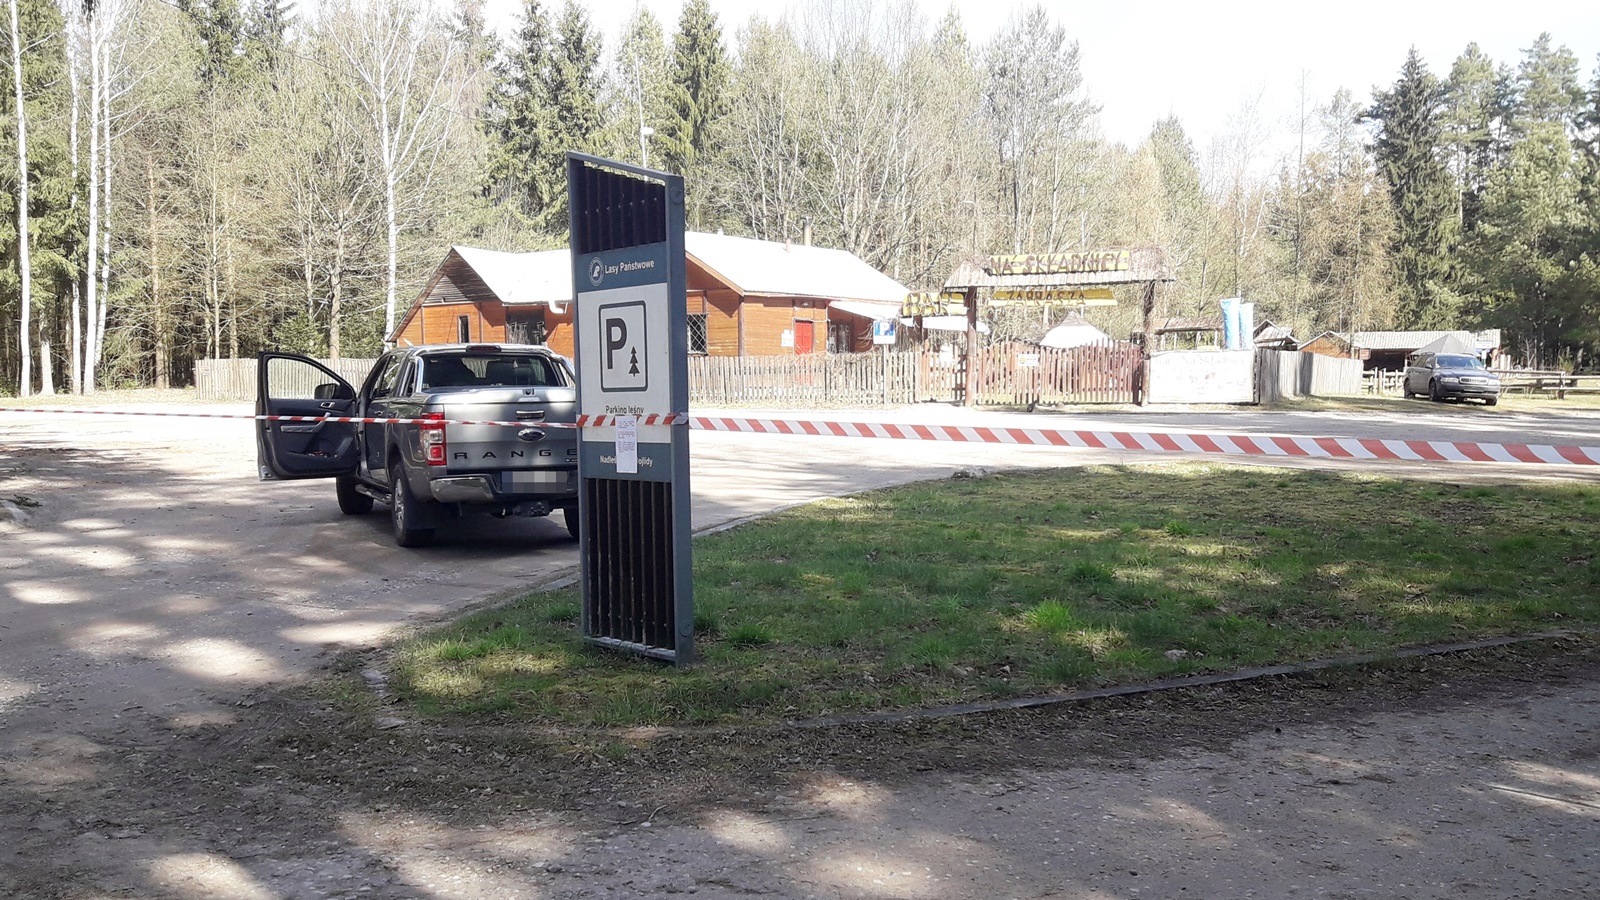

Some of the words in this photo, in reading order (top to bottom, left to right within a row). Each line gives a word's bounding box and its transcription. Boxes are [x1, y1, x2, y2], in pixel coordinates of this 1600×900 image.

[604, 265, 619, 275] Lasy
[619, 260, 655, 272] Państwowe
[905, 291, 951, 317] BAR
[605, 317, 627, 370] P
[638, 456, 653, 467] ojlidy
